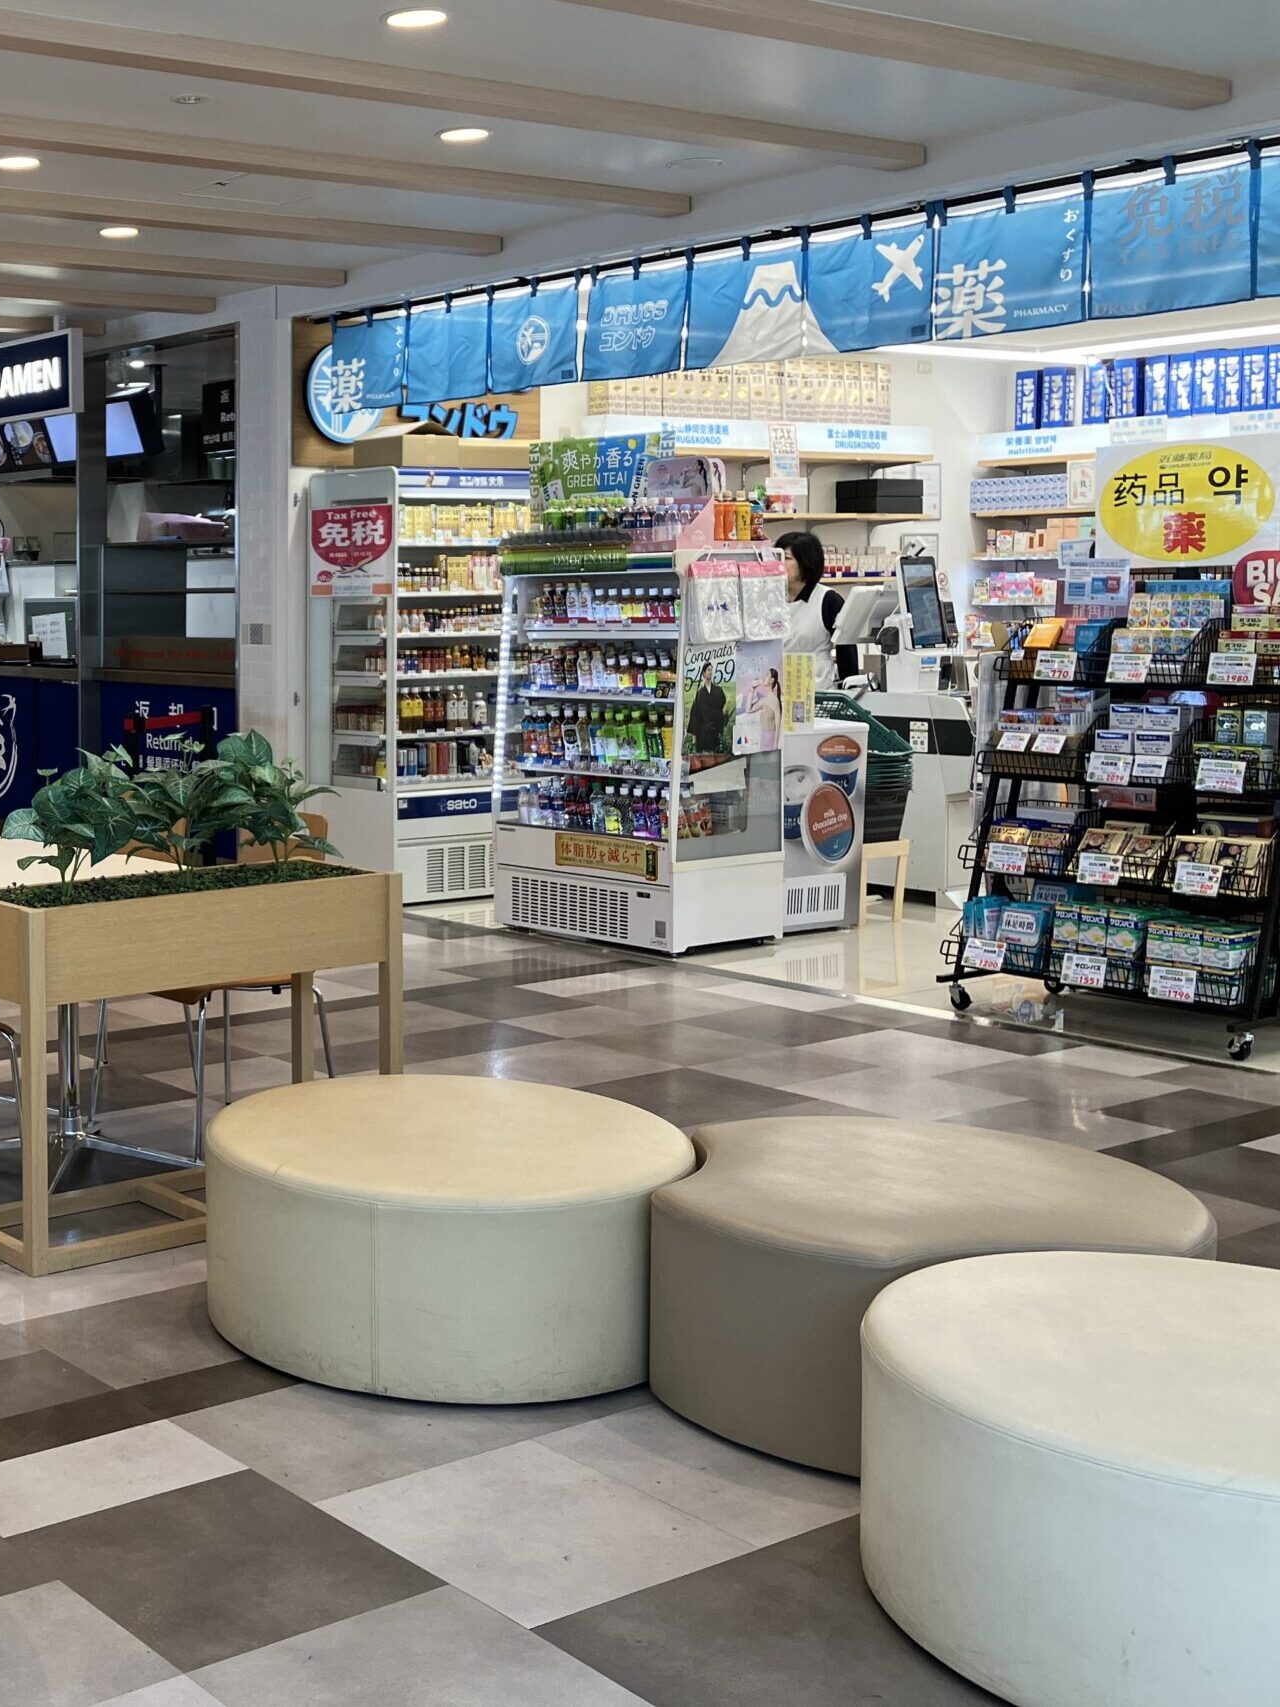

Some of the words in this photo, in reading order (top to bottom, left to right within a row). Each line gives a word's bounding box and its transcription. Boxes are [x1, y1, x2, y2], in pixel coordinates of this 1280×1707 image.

[1060, 207, 1081, 281] おくすり
[931, 258, 1007, 338] 薬
[600, 299, 669, 328] DRUGS
[1013, 303, 1070, 318] PHARMACY
[599, 326, 656, 352] コンドウ
[329, 357, 367, 415] 薬
[675, 435, 721, 445] RUGSKONDO
[772, 427, 793, 441] TAX
[834, 440, 881, 450] DRUGSKONDO
[1007, 445, 1053, 455] nutritional
[560, 447, 633, 475] 爽やか香る
[566, 469, 601, 489] GREEN
[602, 466, 627, 485] TEA!
[1113, 472, 1184, 508] 药品
[1206, 463, 1249, 505] 약
[326, 511, 348, 521] Tax
[350, 510, 377, 519] Free
[318, 519, 386, 548] 免税
[1162, 511, 1206, 554] 薬
[553, 552, 619, 566] OMOTENASHI
[1246, 557, 1280, 588] BI
[1050, 670, 1070, 678] 770
[1224, 674, 1249, 683] 1980
[446, 798, 478, 811] sato
[823, 808, 836, 819] milk
[812, 817, 837, 832] chocolate
[560, 840, 641, 866] 体脂肪を減らす
[1004, 918, 1034, 931] 休足時間
[979, 959, 999, 969] 1200
